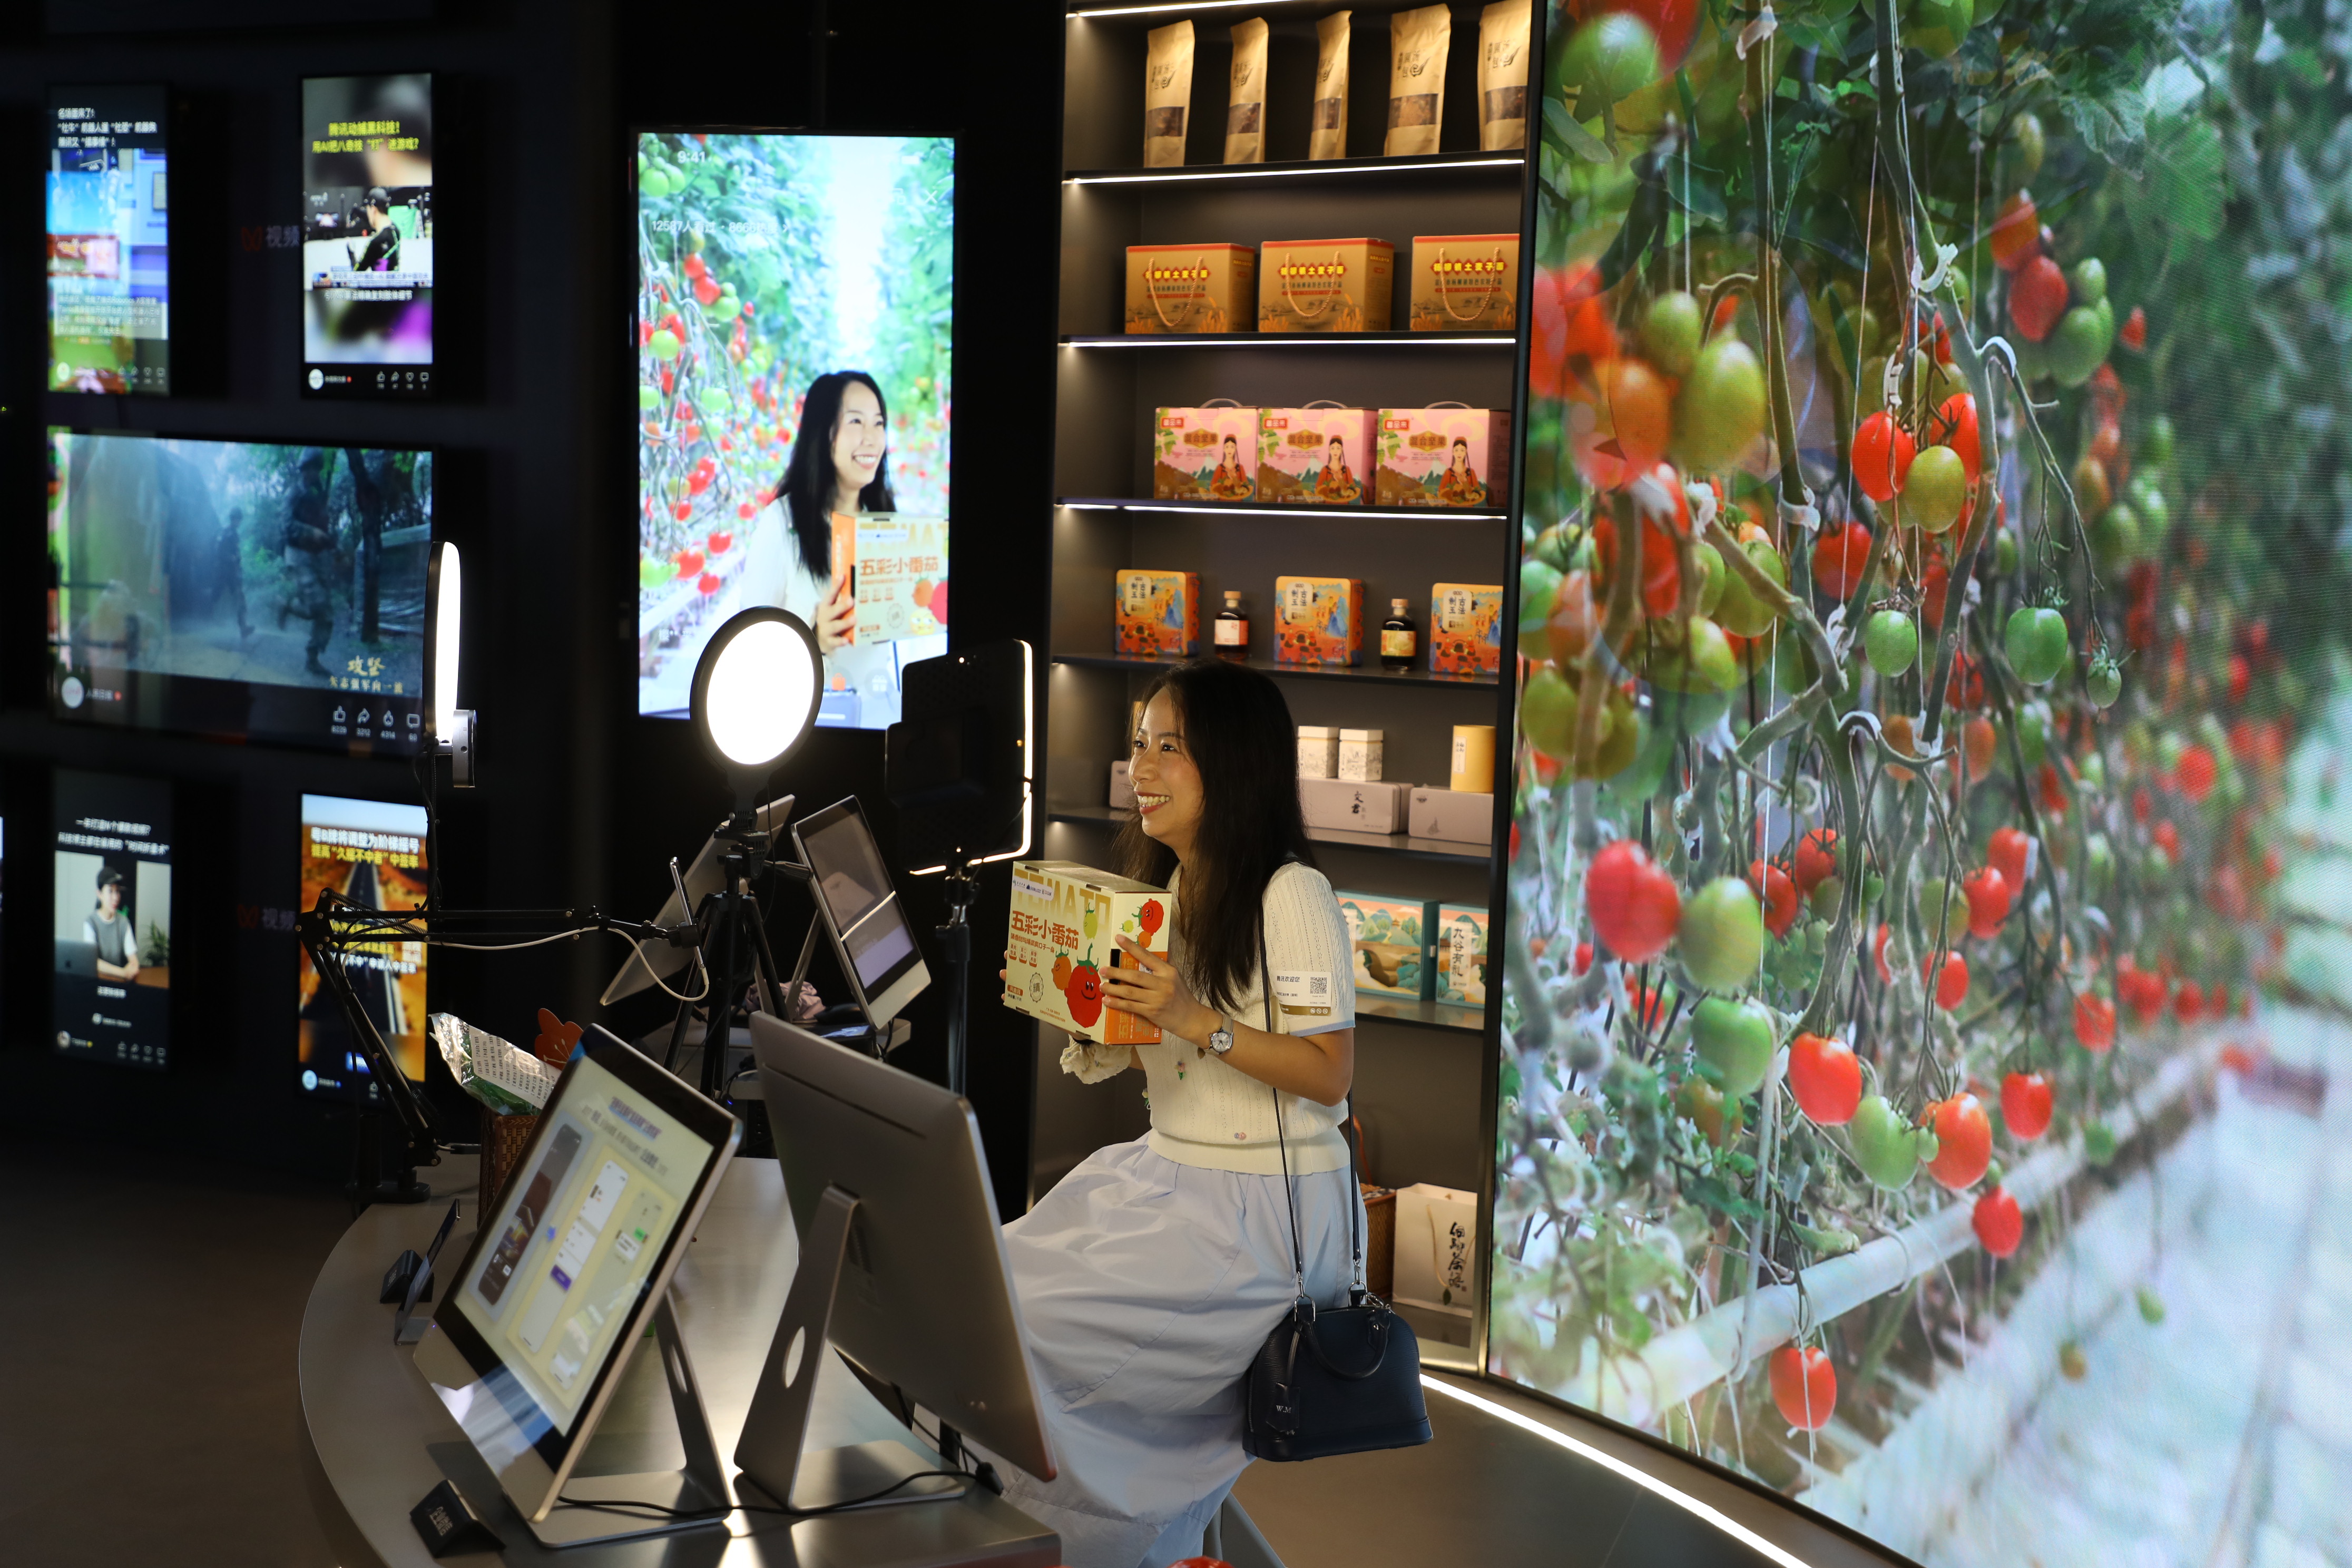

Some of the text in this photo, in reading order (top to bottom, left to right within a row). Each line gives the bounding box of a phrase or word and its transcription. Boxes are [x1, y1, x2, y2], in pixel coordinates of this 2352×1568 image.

[678, 151, 705, 164] 9:41
[1289, 435, 1322, 443] 混合坚果
[1411, 436, 1445, 446] 混合坚果
[860, 556, 938, 576] 五彩小番茄
[1011, 910, 1079, 950] 五彩小番茄
